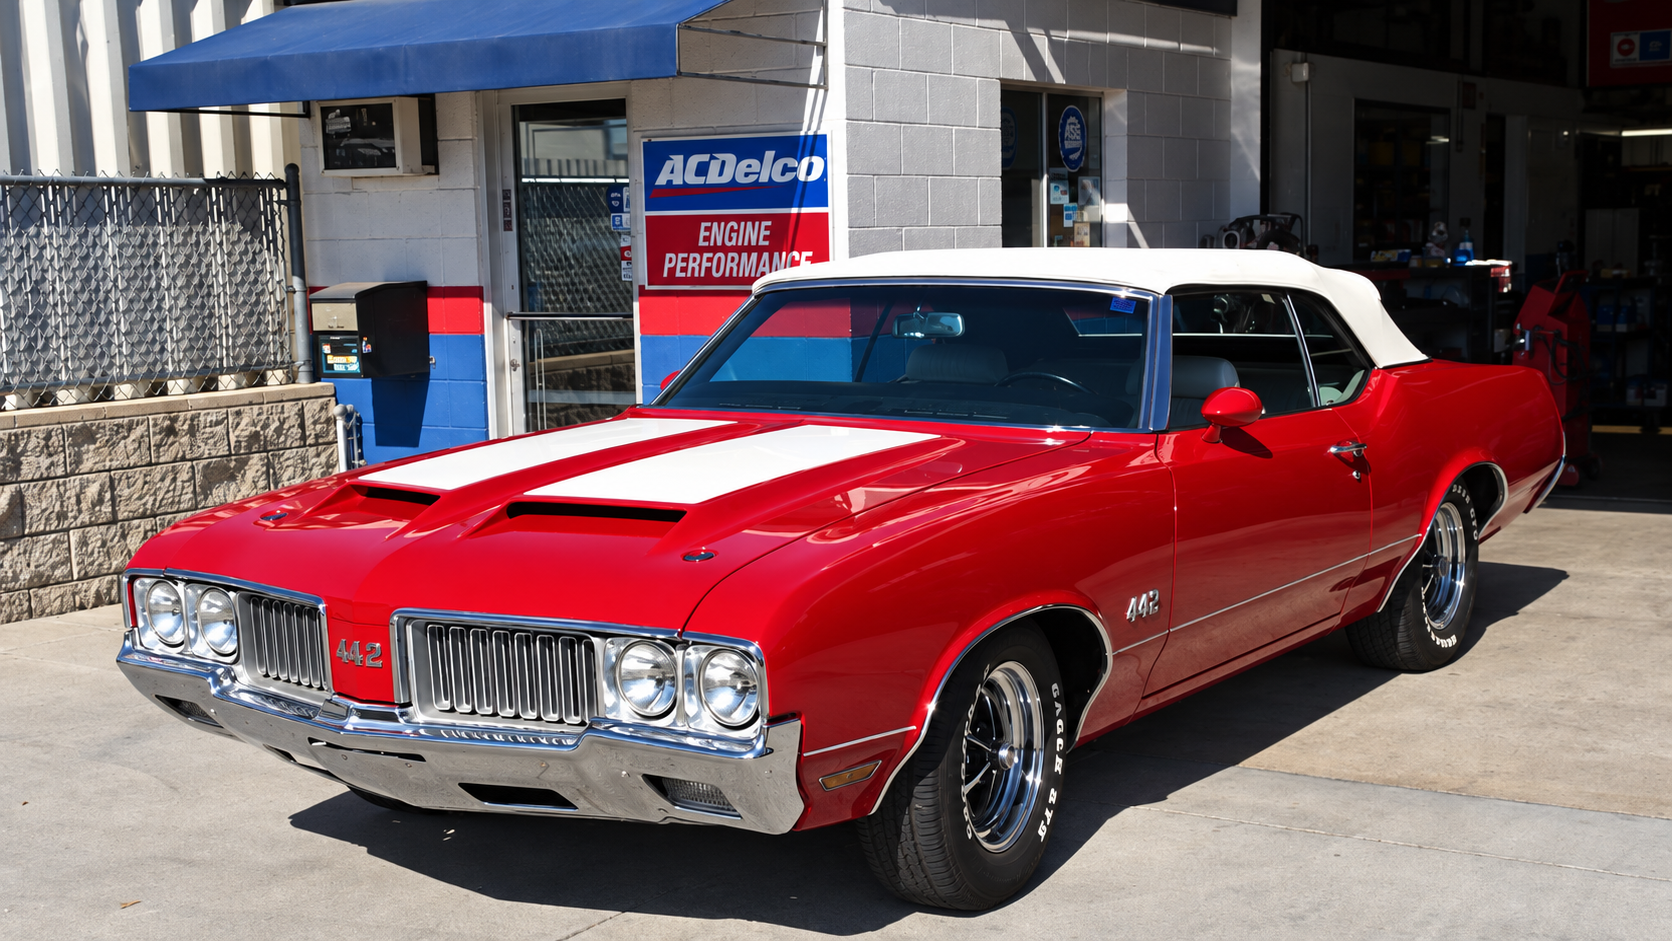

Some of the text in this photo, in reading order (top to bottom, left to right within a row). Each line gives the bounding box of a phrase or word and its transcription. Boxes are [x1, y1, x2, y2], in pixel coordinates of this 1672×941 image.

[655, 150, 825, 186] ACDelco
[698, 220, 772, 247] ENGINE
[1125, 589, 1159, 623] 442
[336, 638, 383, 668] 442
